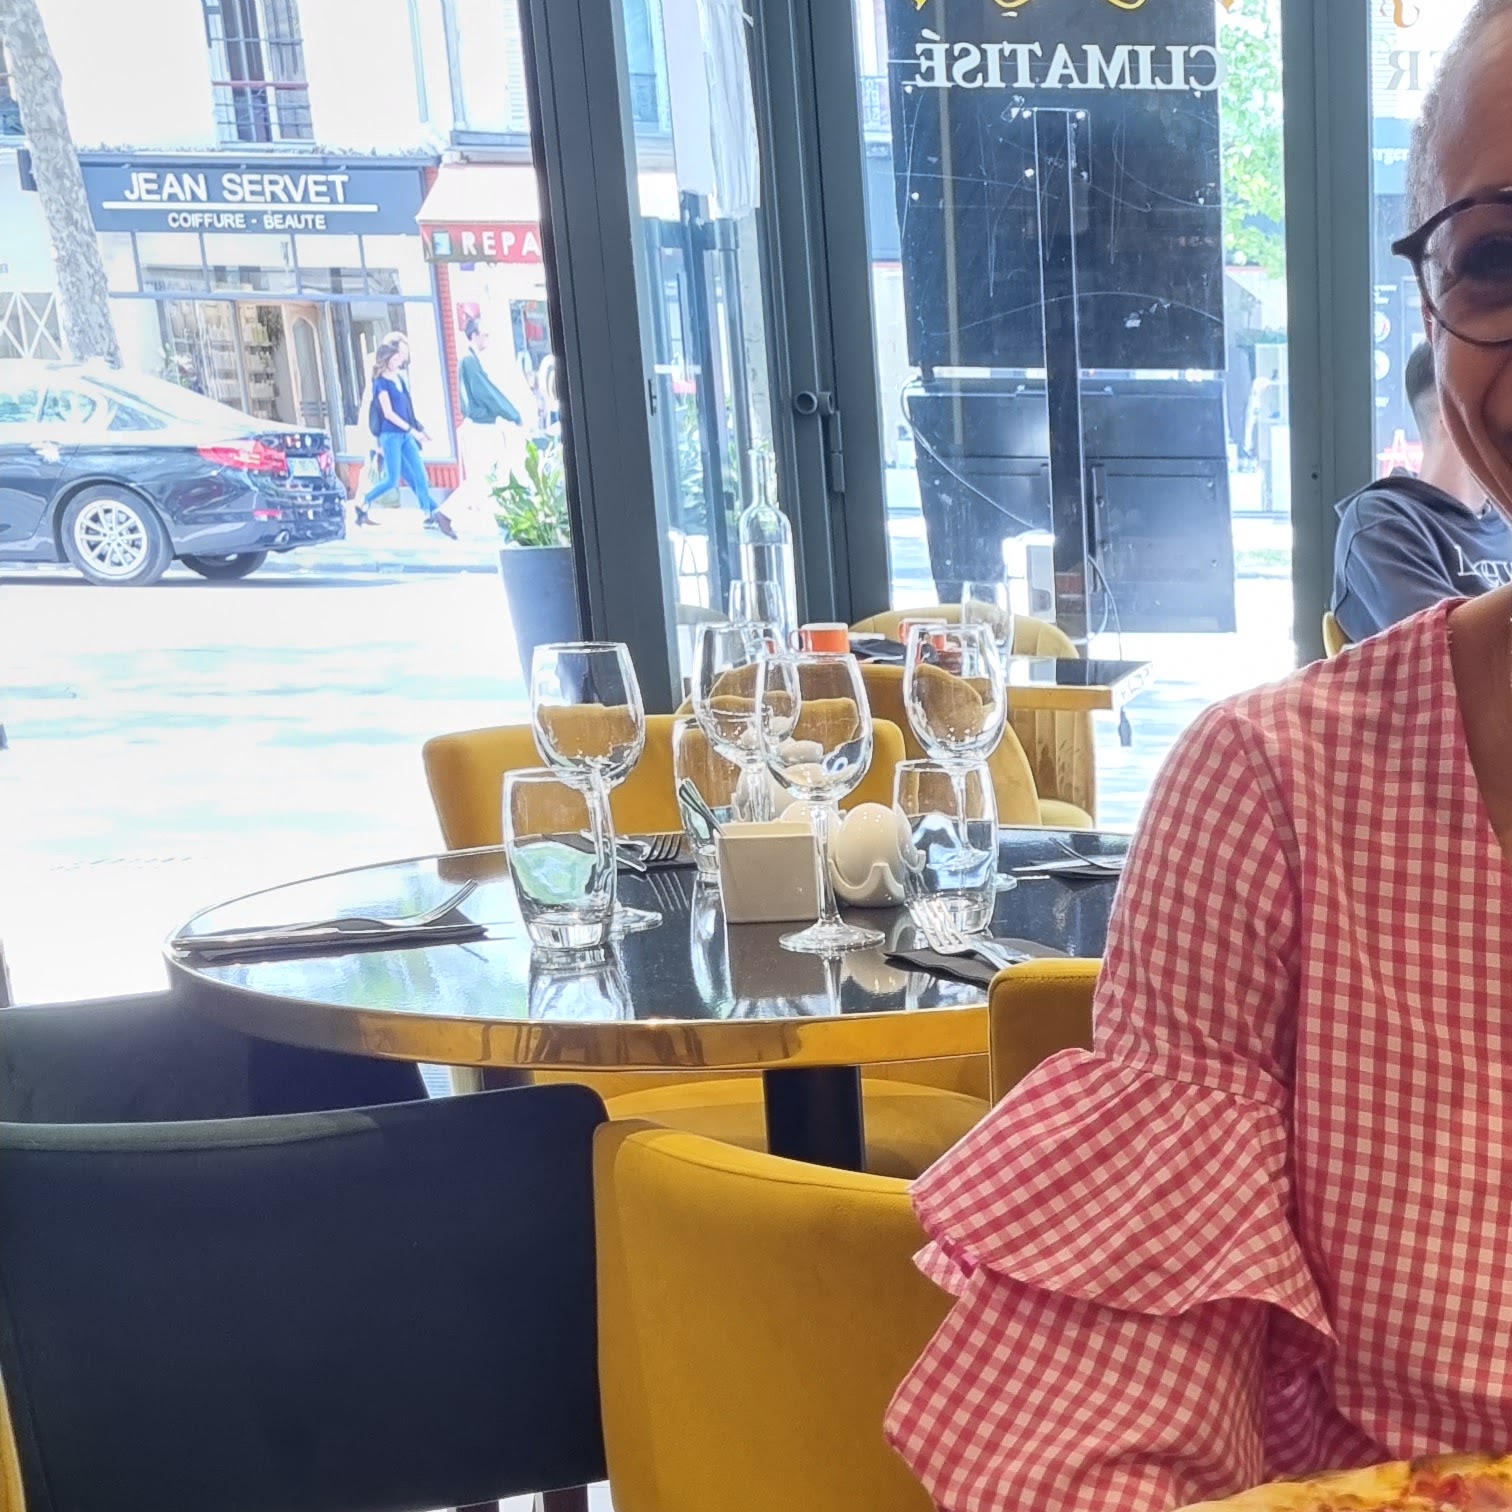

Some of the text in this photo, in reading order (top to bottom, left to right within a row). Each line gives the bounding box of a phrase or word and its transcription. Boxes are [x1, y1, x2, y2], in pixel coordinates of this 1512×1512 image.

[124, 172, 349, 203] JEAN SERVET
[167, 212, 246, 229] COIFFURE
[263, 212, 326, 229] BEAUTE
[461, 231, 541, 256] REPA
